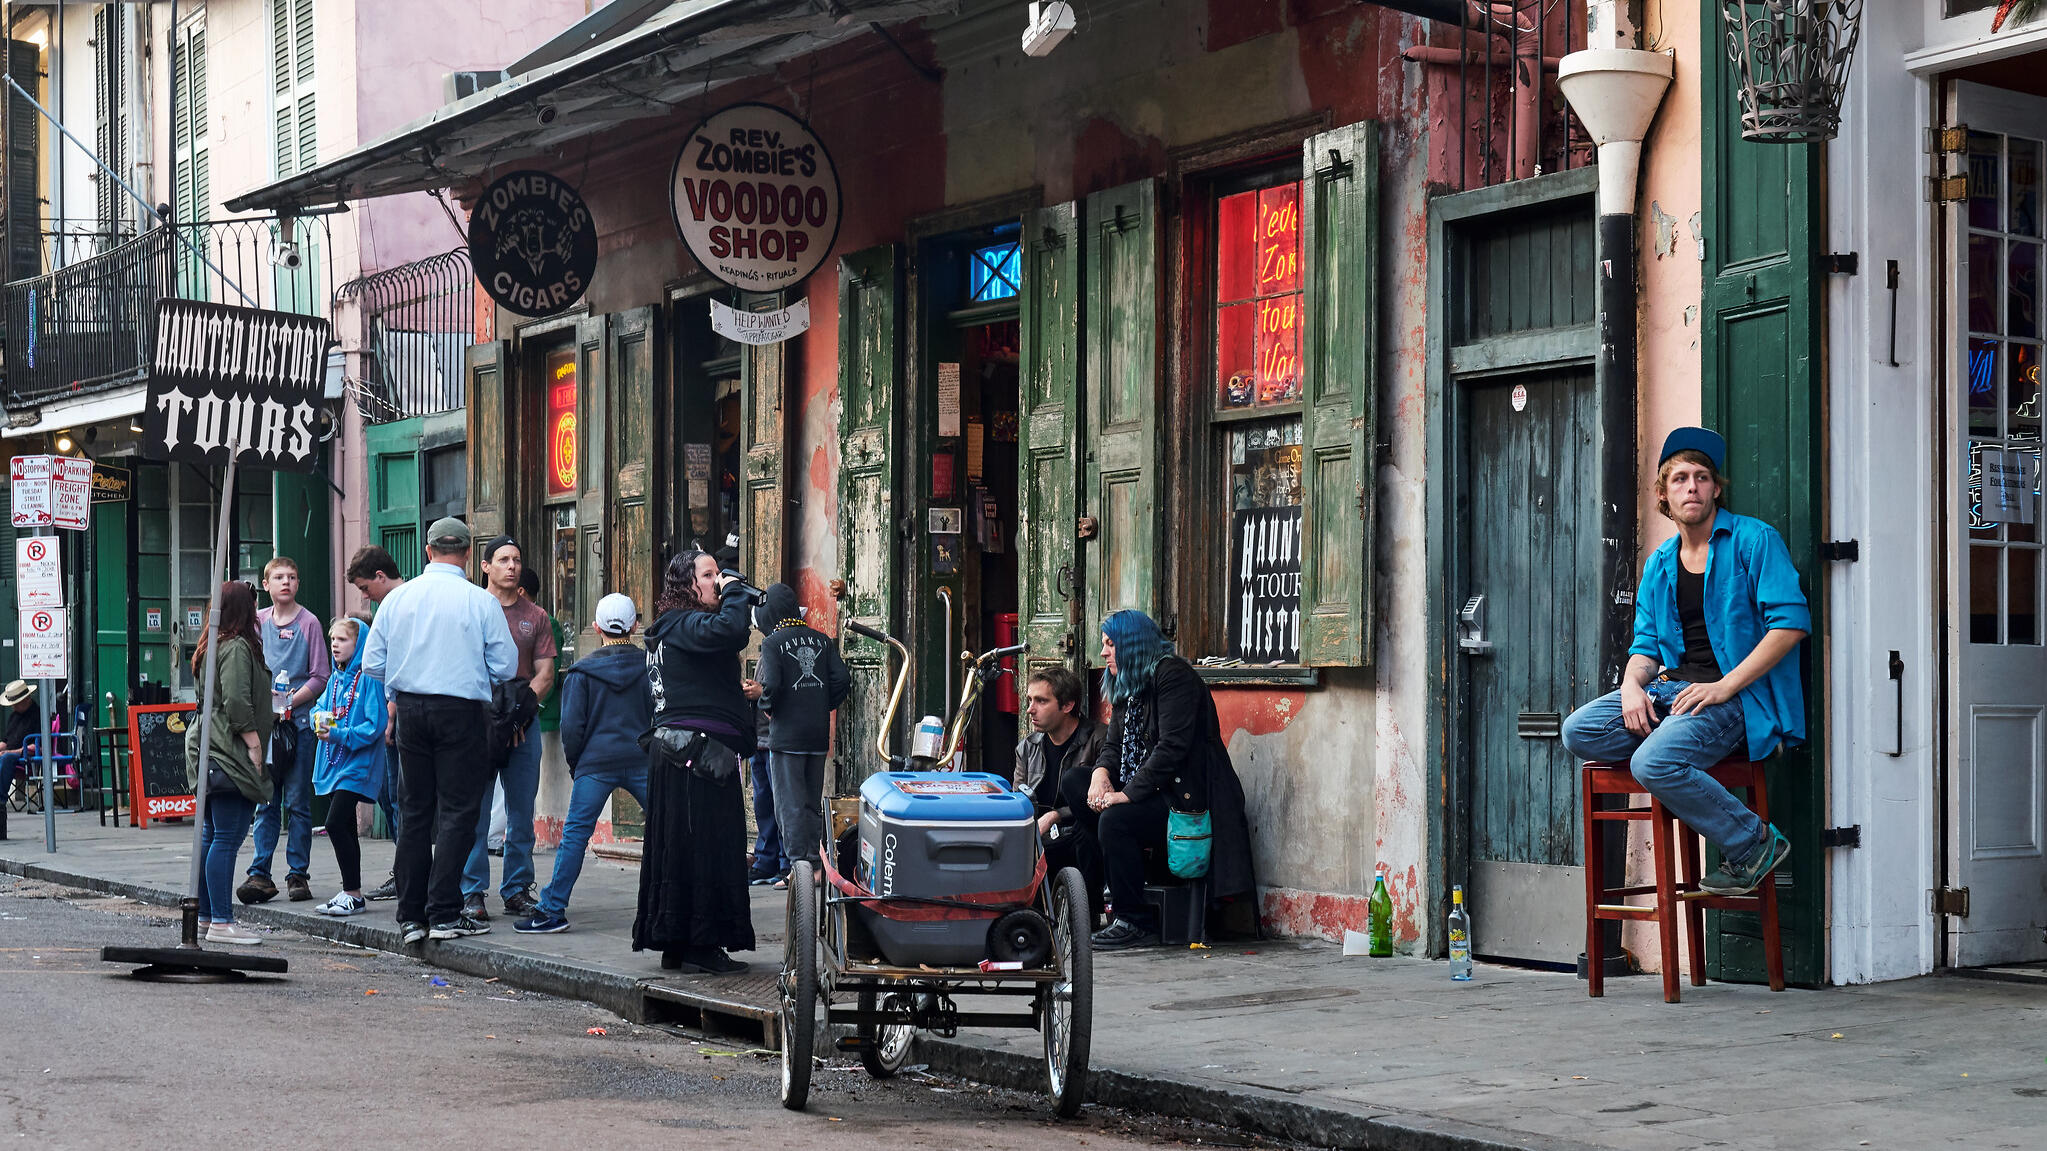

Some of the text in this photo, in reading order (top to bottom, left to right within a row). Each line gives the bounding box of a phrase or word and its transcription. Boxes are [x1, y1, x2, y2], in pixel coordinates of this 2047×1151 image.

[730, 128, 784, 150] REV.
[695, 135, 816, 178] ZOMBIE'S
[480, 175, 587, 234] ZOMBIE'S
[683, 177, 828, 228] VOODOO
[709, 226, 809, 262] SHOP
[719, 264, 798, 281] READINGS RITUALS
[493, 269, 582, 310] CIGARS
[734, 312, 757, 328] HELP
[155, 304, 327, 391] HAUNTED HISTORY
[157, 385, 315, 462] TOURS
[13, 462, 49, 476] NO STOPPING
[53, 462, 90, 477] NO PARKING
[55, 482, 87, 494] FREIGHT
[59, 493, 80, 504] ZONE
[92, 491, 125, 499] ITCHEN
